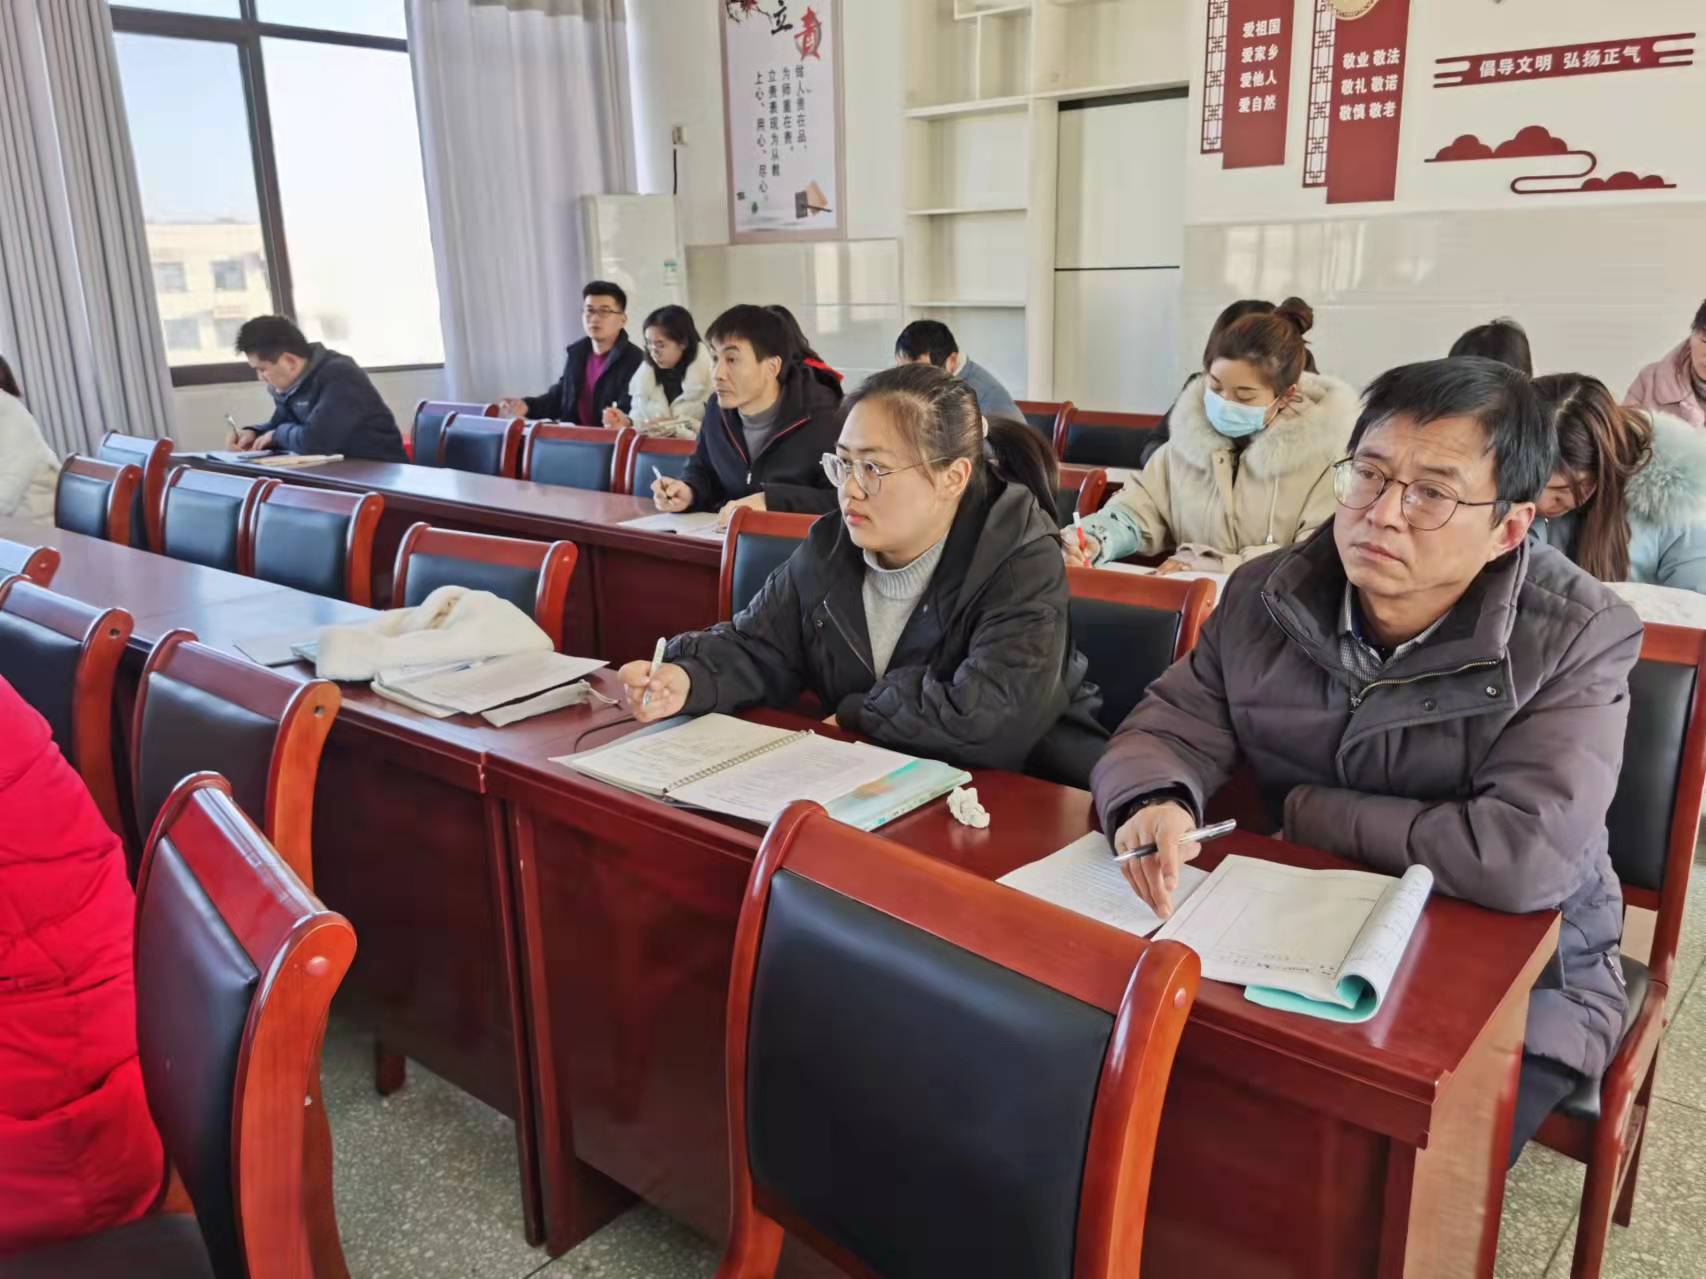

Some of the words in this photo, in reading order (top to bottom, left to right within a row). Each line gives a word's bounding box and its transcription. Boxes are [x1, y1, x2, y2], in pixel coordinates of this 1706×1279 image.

[1242, 18, 1281, 38] 爱祖国
[1241, 44, 1279, 63] 爱家乡
[1343, 51, 1369, 69] 敬业
[1373, 48, 1400, 66] 敬法
[1479, 54, 1552, 78] 倡导文明
[1563, 46, 1641, 69] 弘扬正气
[1240, 70, 1277, 88] 爱他人
[1341, 78, 1367, 95] 敬礼
[1371, 75, 1398, 93] 敬诺
[1238, 95, 1276, 113] 爱自然
[1369, 101, 1396, 119] 敬老
